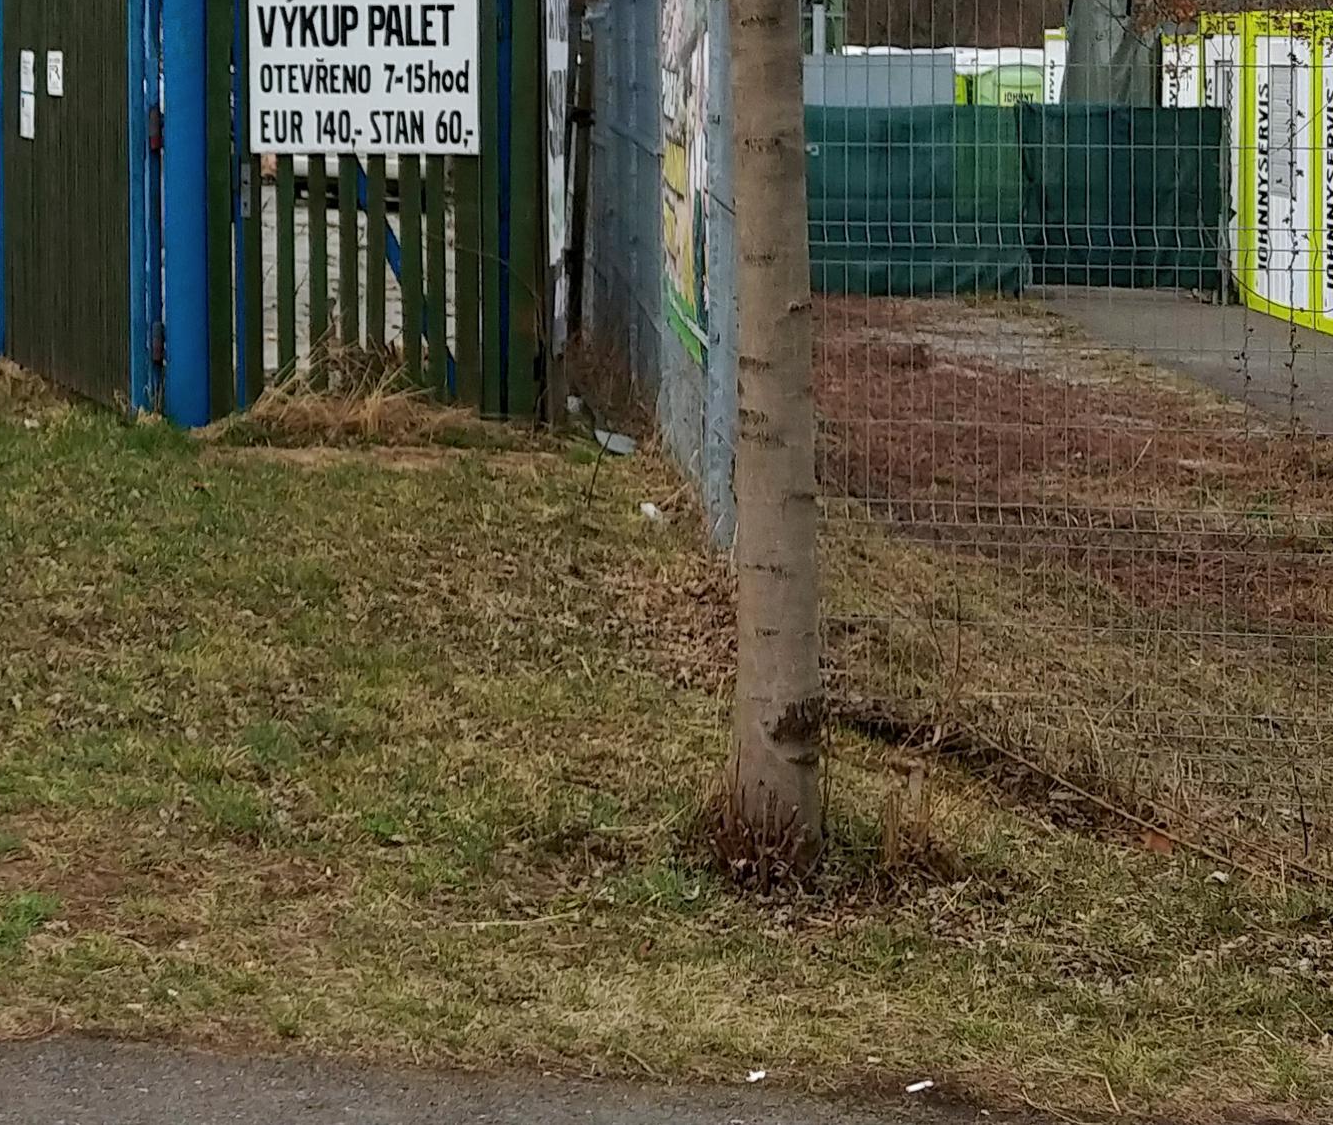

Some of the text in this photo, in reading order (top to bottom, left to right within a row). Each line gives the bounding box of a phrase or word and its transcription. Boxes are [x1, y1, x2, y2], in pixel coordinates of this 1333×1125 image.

[367, 4, 455, 47] PALET
[260, 57, 371, 94] OTEVŘENO
[260, 109, 474, 148] EUR 140,- STAN 60,-
